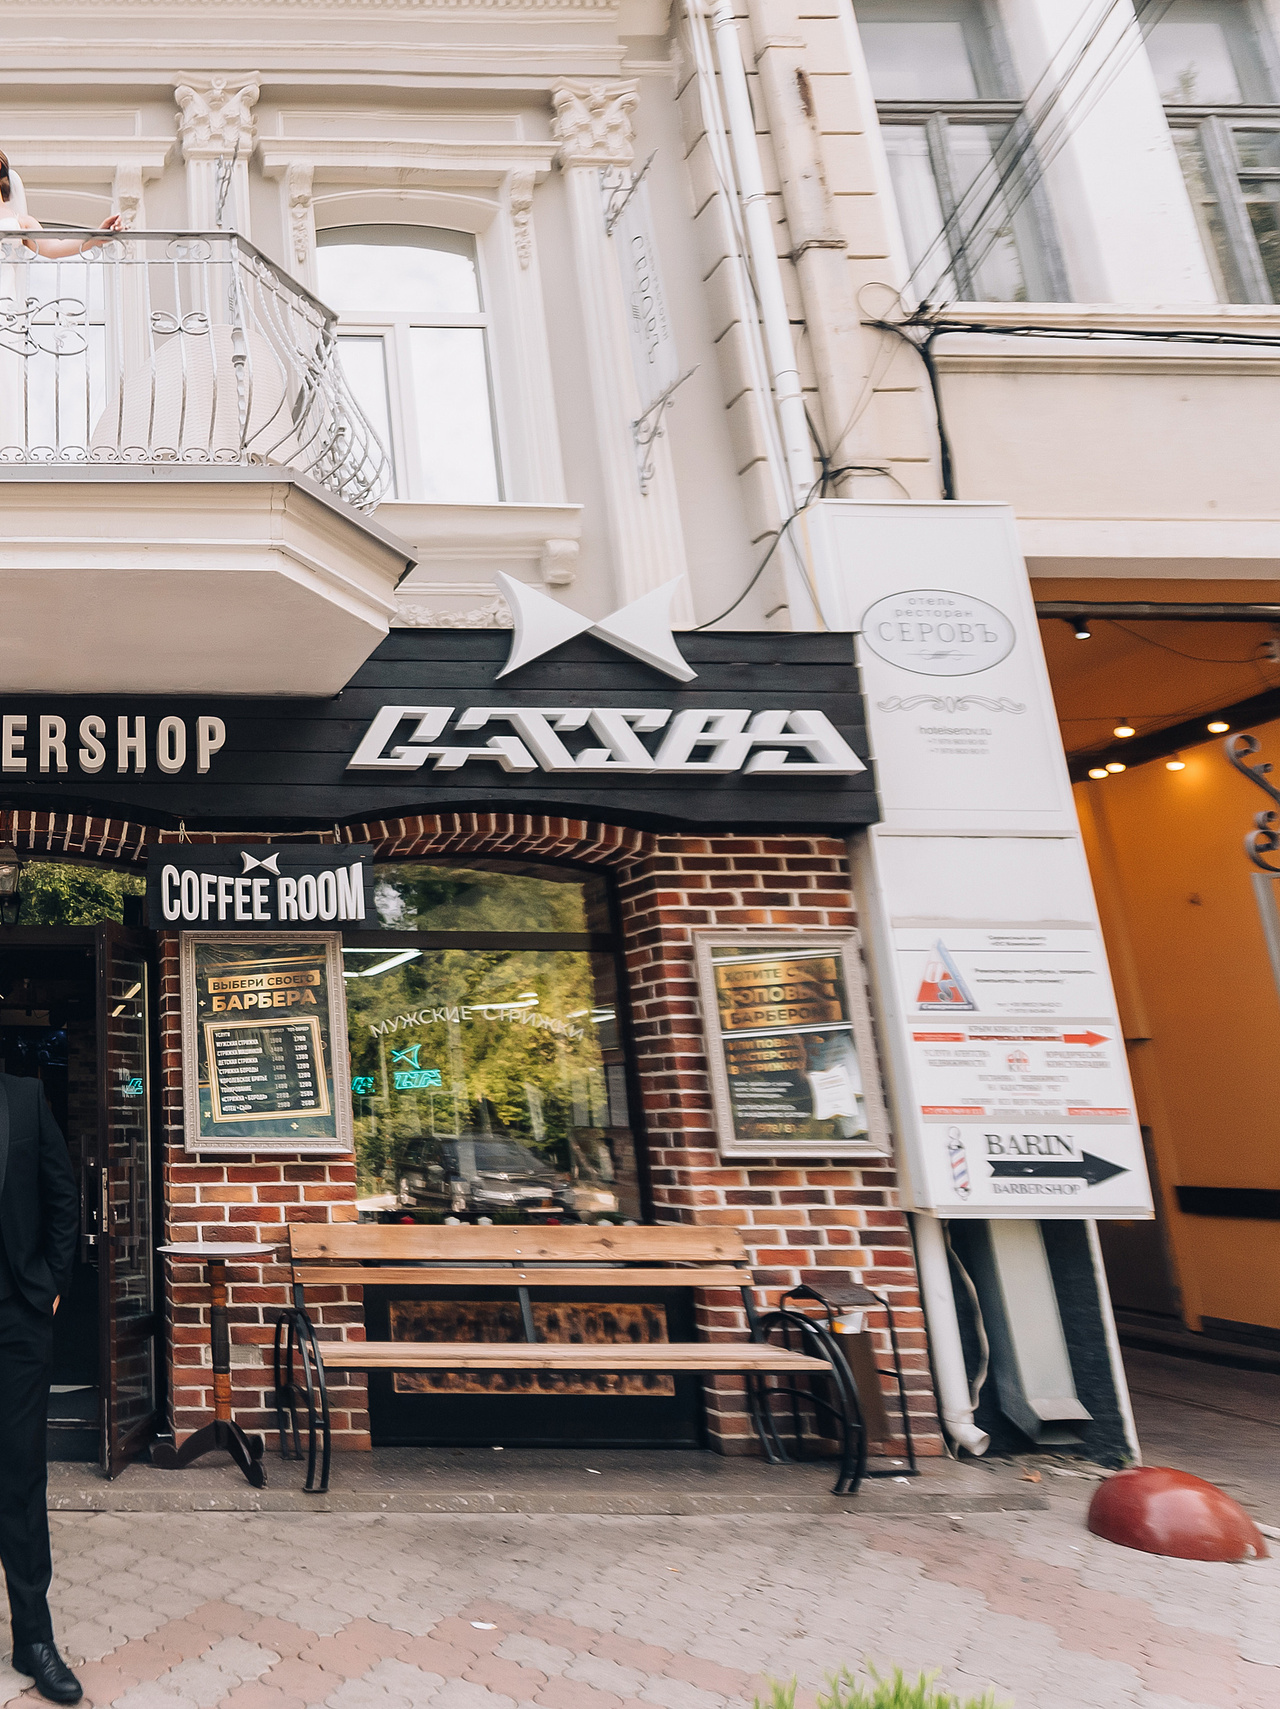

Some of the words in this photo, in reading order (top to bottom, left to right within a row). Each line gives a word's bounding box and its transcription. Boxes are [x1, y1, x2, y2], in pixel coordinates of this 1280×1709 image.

[908, 597, 956, 606] отель
[894, 609, 973, 619] ресторан
[877, 621, 998, 643] СЕРОВЪ
[161, 864, 271, 921] COFFEE
[277, 862, 366, 922] ROOM
[212, 978, 264, 991] ВЫБЕРИ
[267, 974, 315, 986] СВОЕГО
[724, 968, 783, 982] ХОТИТЕ
[212, 989, 318, 1012] БАРБЕРА
[370, 1006, 473, 1039] МУЖСКИЕ
[482, 1008, 585, 1042] СТРИЖКИ
[730, 1006, 828, 1024] БАРБЕРО
[984, 1134, 1075, 1156] BARIN
[993, 1183, 1081, 1195] BARBERSHOP
